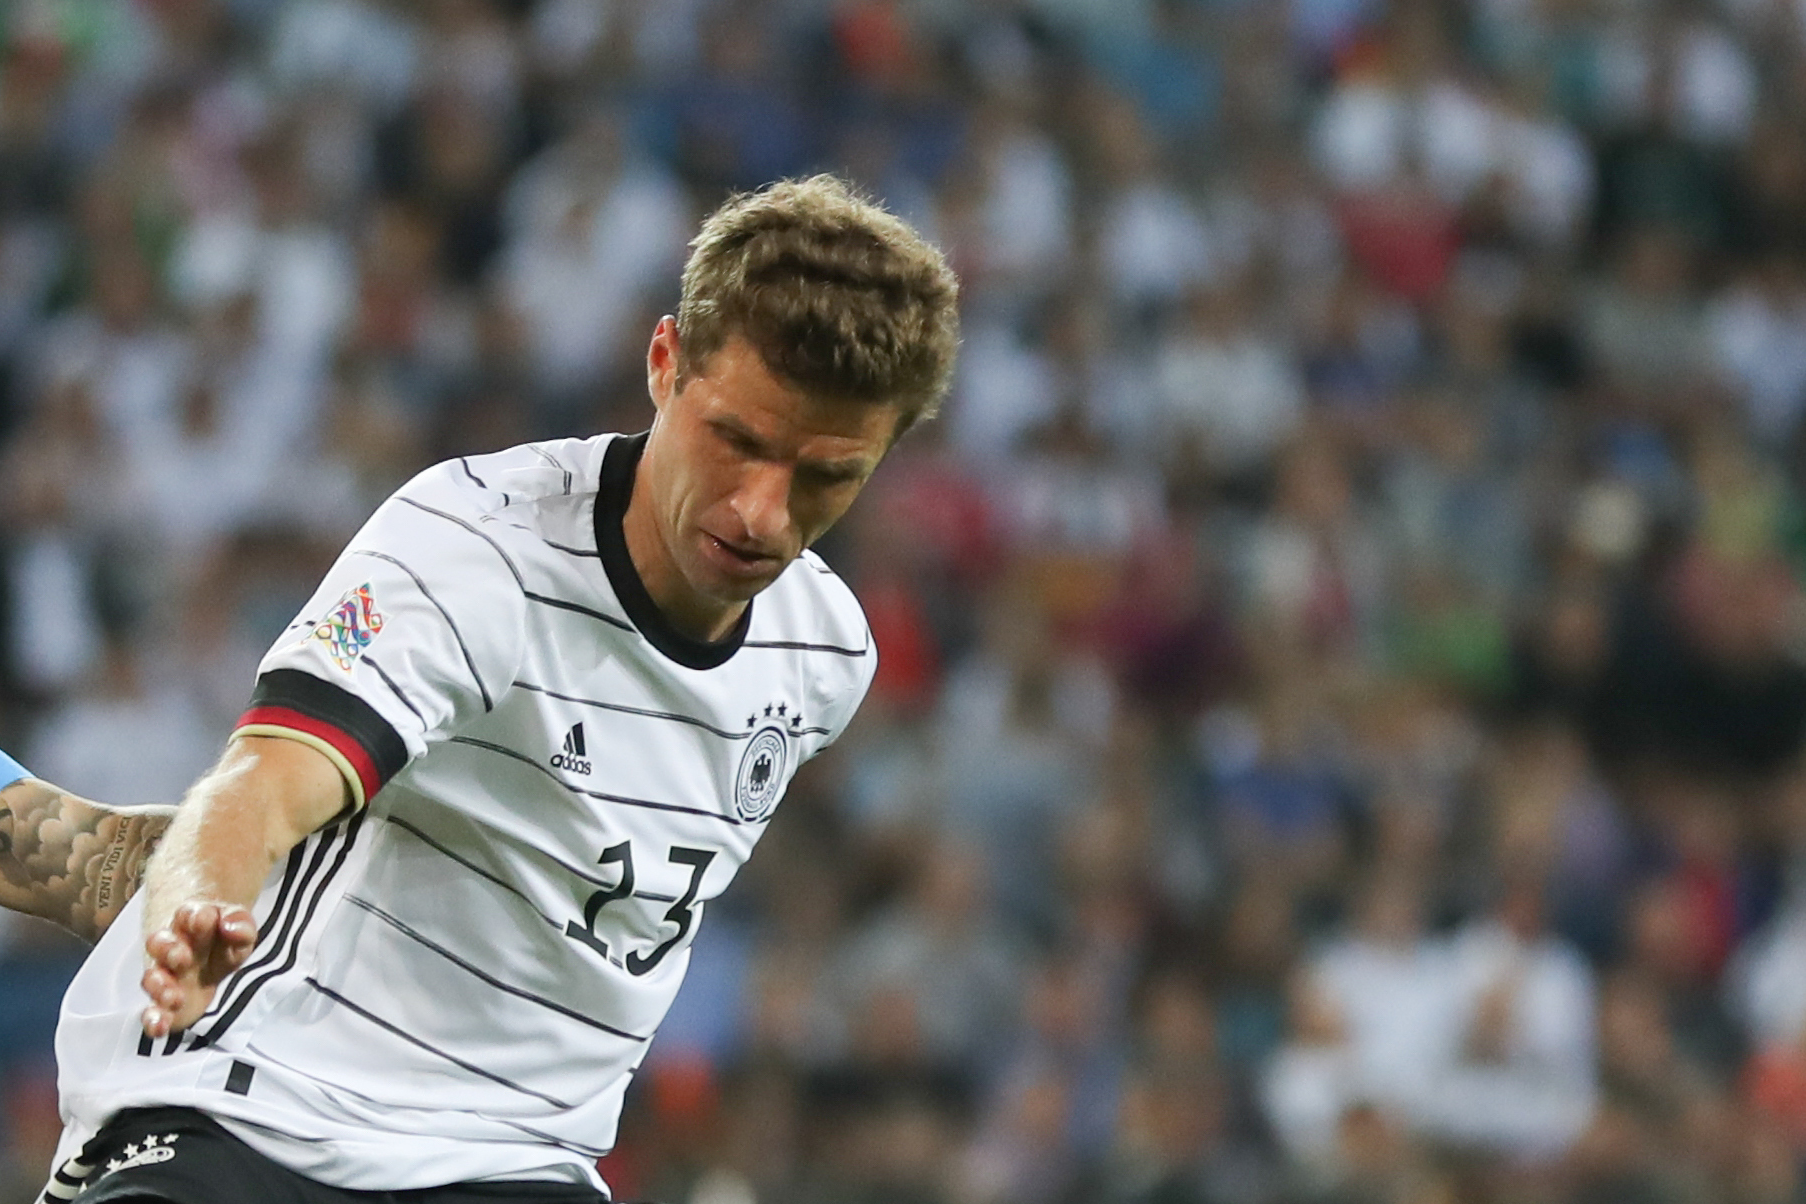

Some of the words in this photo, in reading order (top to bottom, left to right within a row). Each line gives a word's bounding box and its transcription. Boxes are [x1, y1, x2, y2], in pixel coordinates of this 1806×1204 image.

[115, 816, 132, 844] VICI
[103, 846, 124, 872] VIDI
[98, 876, 113, 909] VENI
[565, 840, 719, 977] 13
